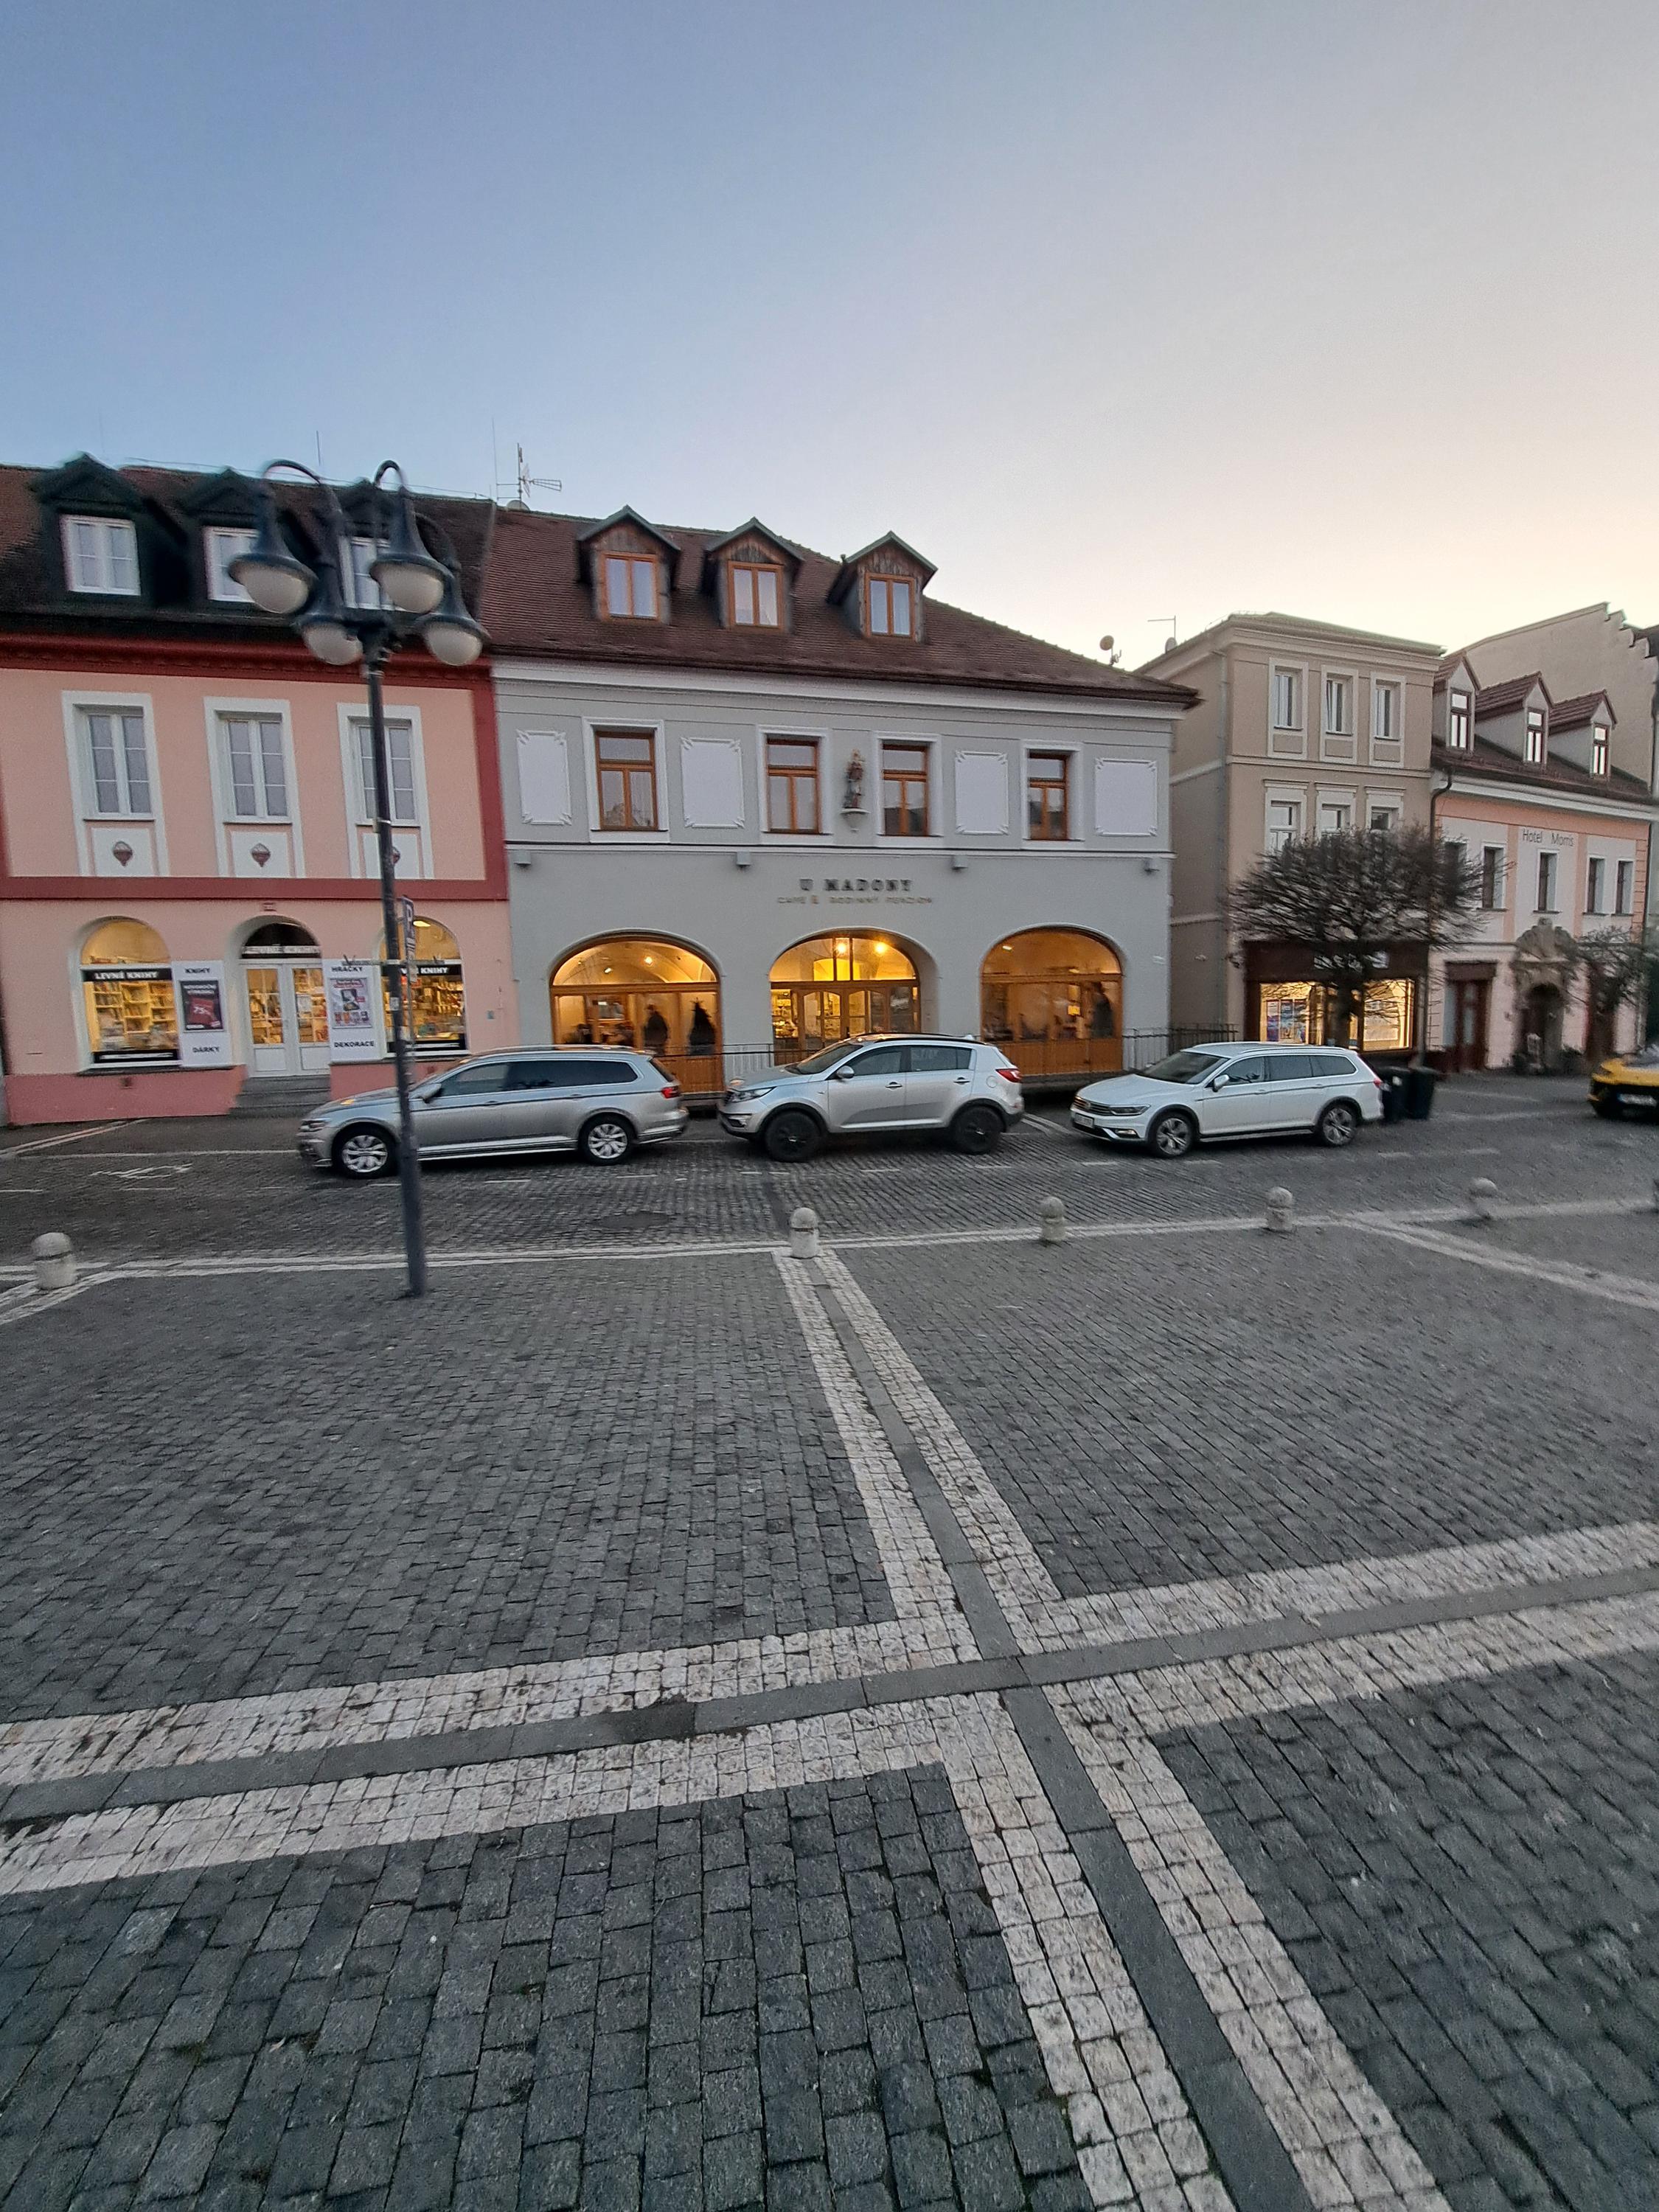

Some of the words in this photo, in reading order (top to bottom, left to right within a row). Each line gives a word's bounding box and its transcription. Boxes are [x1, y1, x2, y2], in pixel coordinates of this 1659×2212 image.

[1522, 828, 1543, 843] Hotel
[1551, 832, 1573, 846] Morris
[799, 878, 813, 891] U
[824, 879, 914, 891] MADONY
[126, 971, 158, 979] KNIHY
